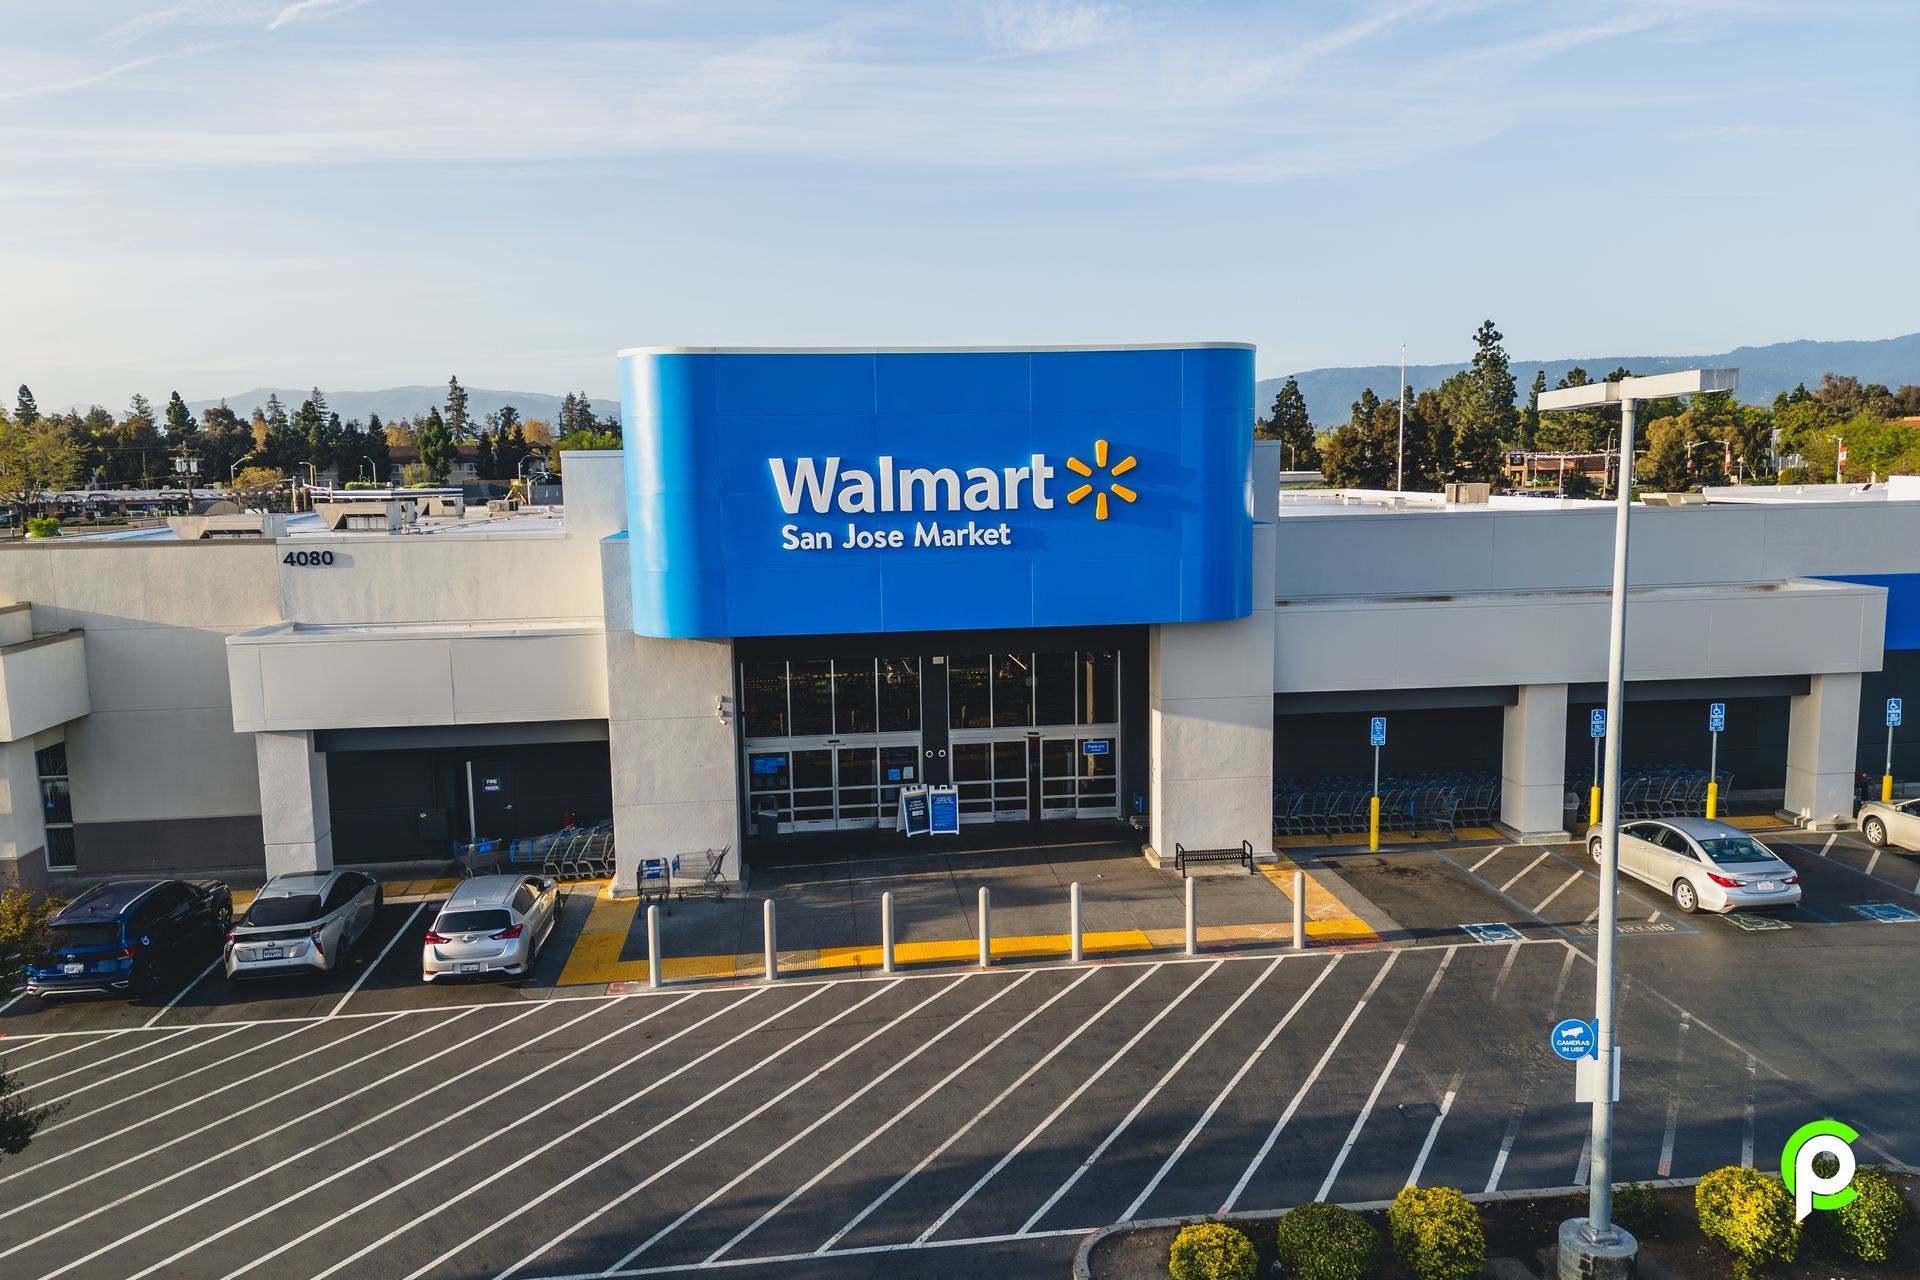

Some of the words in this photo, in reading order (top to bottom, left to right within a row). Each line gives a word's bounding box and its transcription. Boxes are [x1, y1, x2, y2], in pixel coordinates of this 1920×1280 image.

[768, 453, 1055, 515] Walmart
[782, 524, 833, 550] San
[842, 523, 904, 550] Jose
[914, 521, 1012, 548] Market
[282, 550, 334, 566] 4080
[1616, 923, 1675, 933] ARKING
